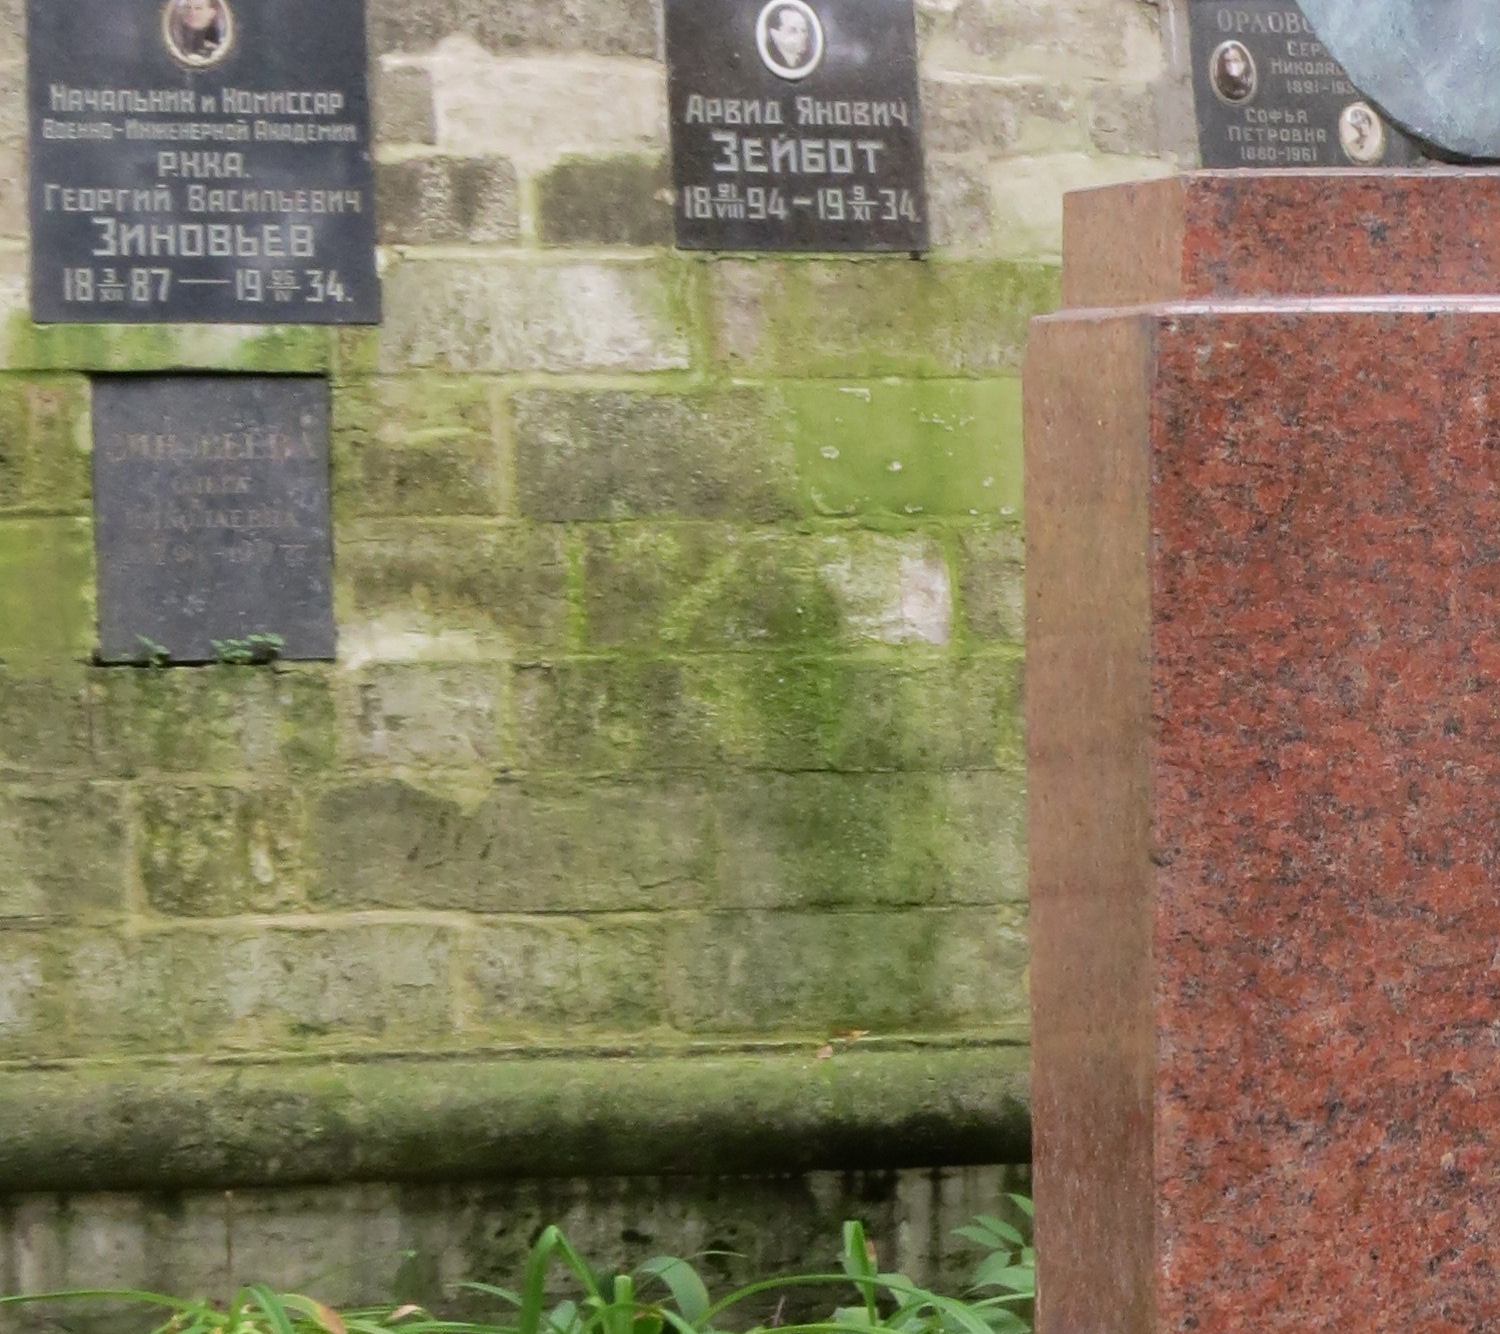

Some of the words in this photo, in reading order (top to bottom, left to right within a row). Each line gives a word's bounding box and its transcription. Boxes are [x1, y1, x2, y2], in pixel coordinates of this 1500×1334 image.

[686, 93, 784, 124] АРВИД
[795, 95, 910, 127] ЯНОВИЧ
[1245, 108, 1309, 125] СОФЬЯ
[1227, 124, 1328, 144] ПЕТРОВНА
[711, 131, 884, 175] ЗЕЙБОТ
[45, 183, 173, 212] ГЕОРГИЙ
[187, 184, 362, 214] ВАСИЛЬЕВИЧ
[92, 217, 316, 257] ЗИНОВЬЕВ
